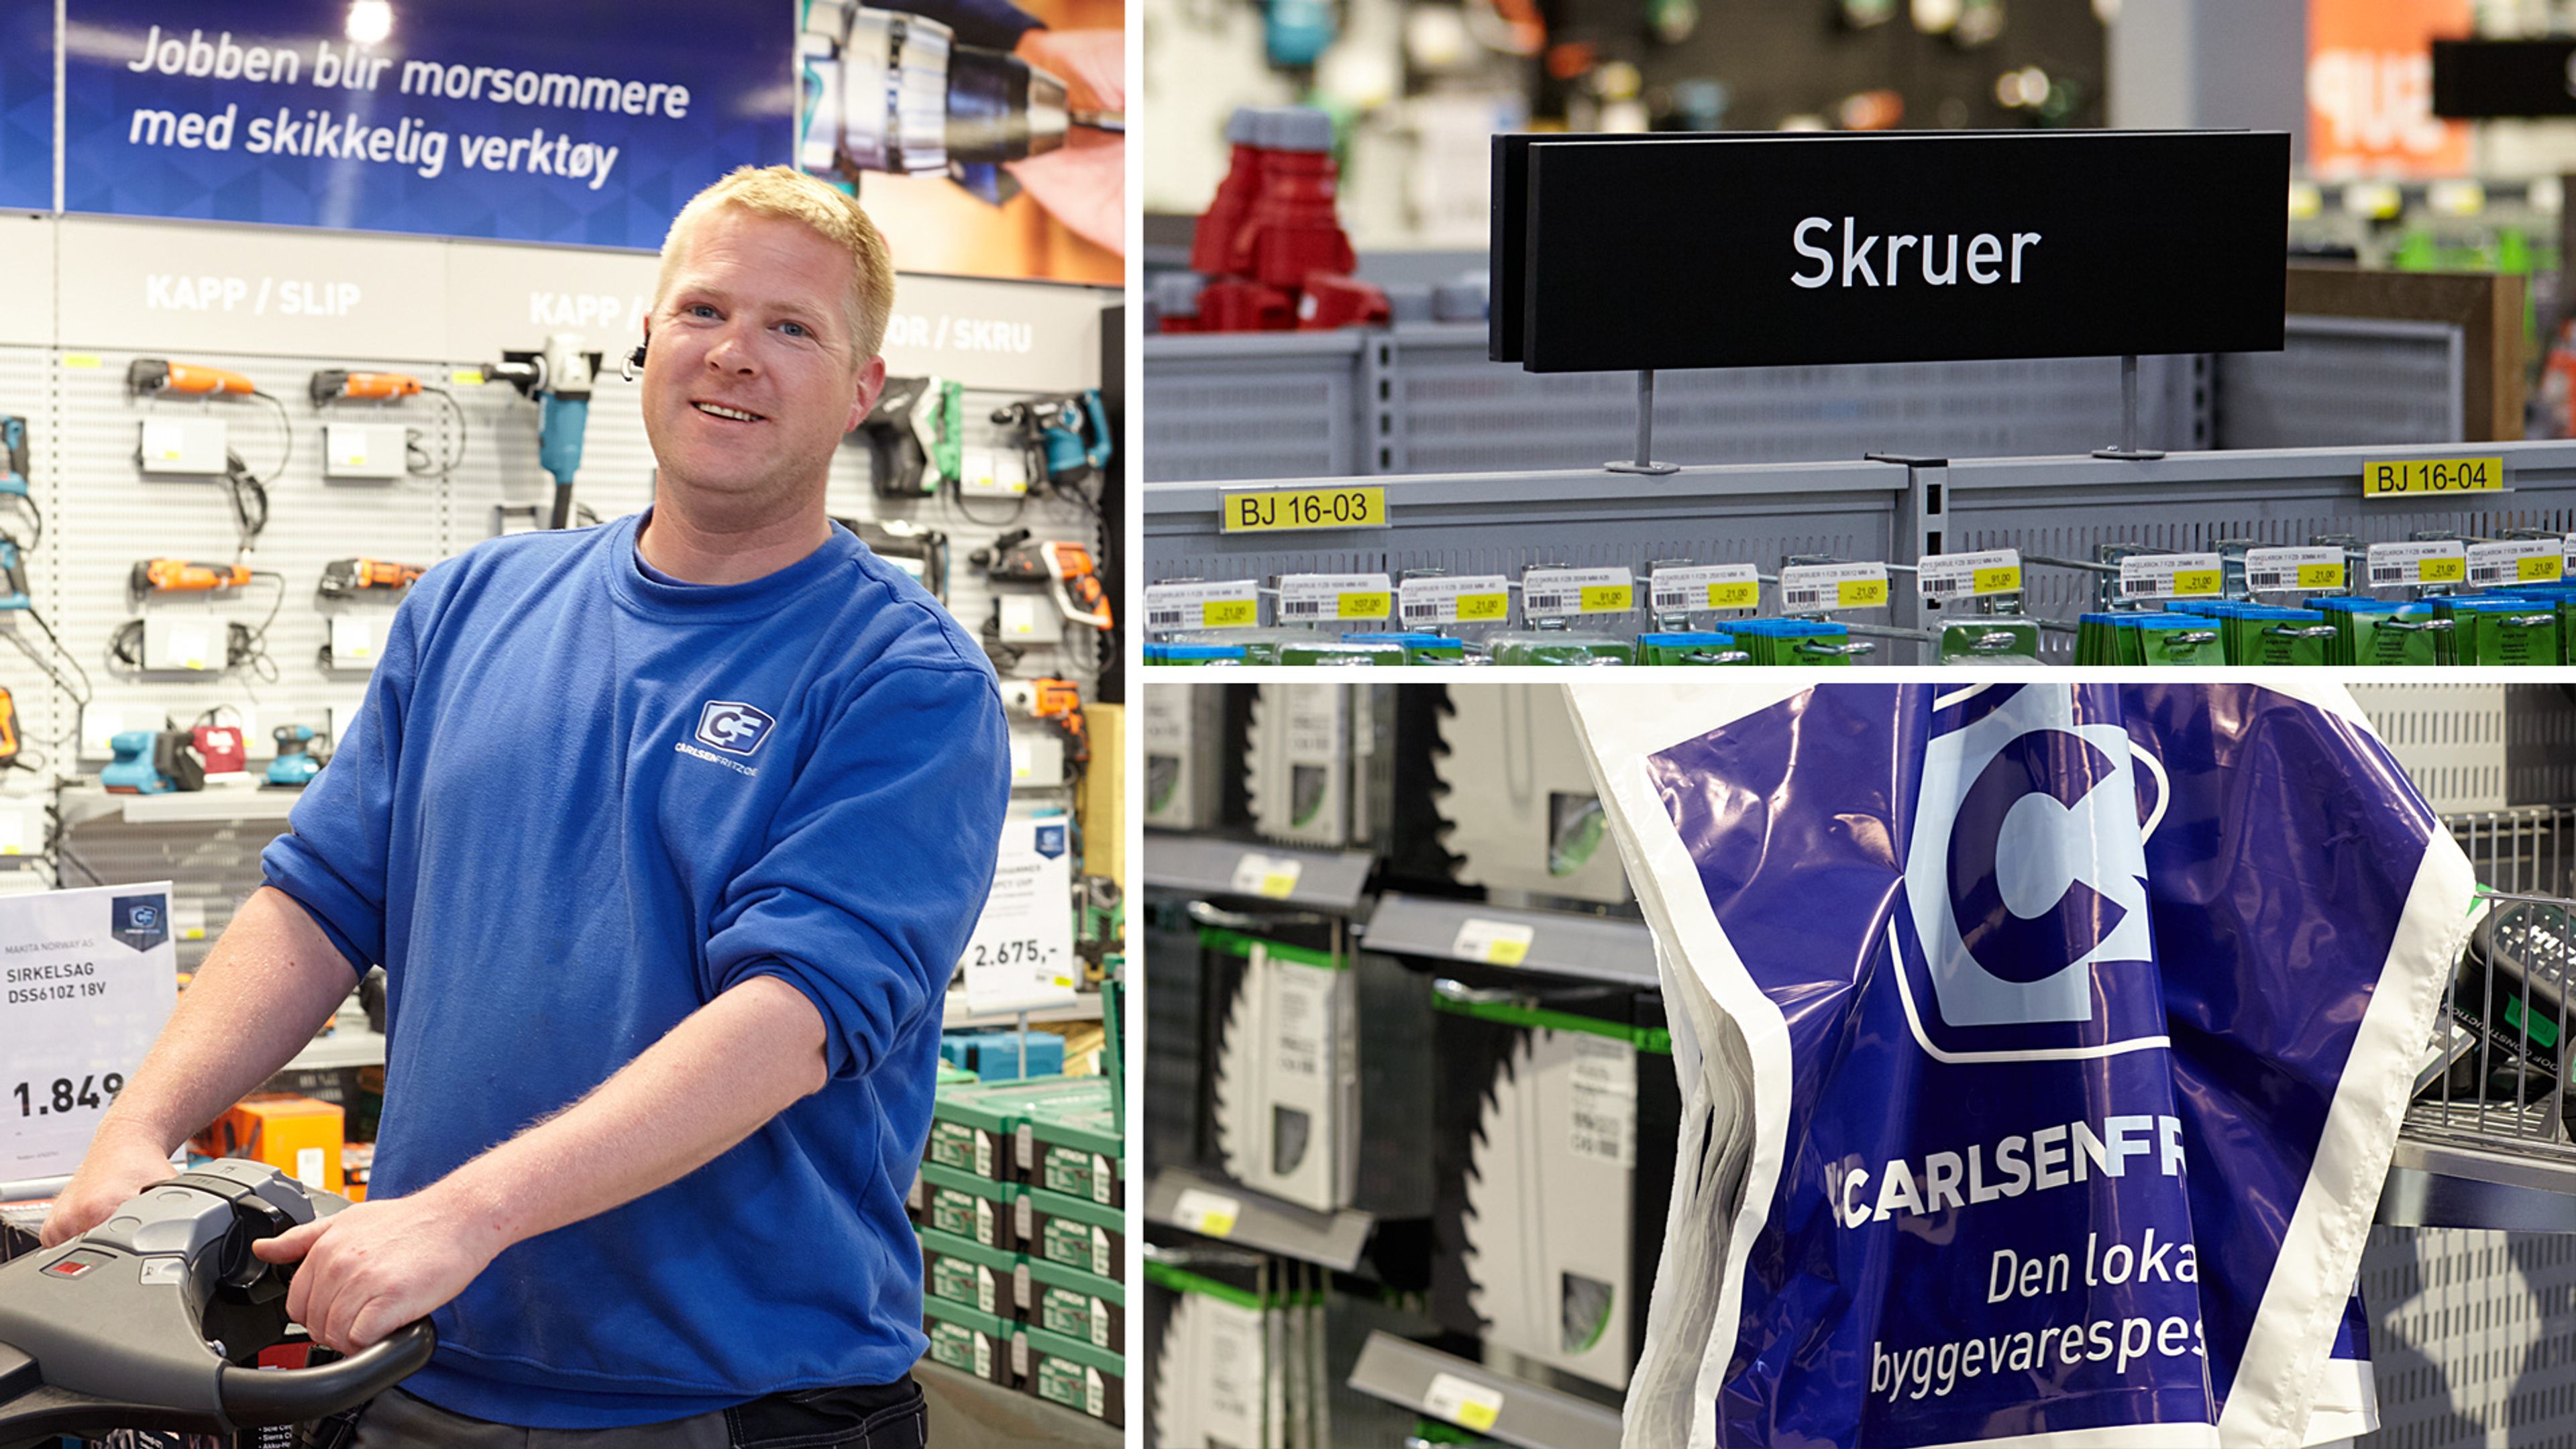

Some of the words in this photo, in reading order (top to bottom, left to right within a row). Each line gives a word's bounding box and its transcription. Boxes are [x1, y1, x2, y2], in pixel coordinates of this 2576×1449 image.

[128, 25, 299, 85] Jobben
[313, 40, 393, 91] blir
[400, 60, 690, 119] morsommere
[129, 103, 237, 150] med
[246, 107, 448, 178] skikkelig
[460, 128, 619, 190] verktøy
[1790, 216, 2041, 288] Skruer
[146, 274, 247, 311] KAPP
[279, 280, 362, 316] SLIP
[531, 292, 621, 327] KAPP
[954, 318, 1032, 354] SKRU
[2378, 465, 2408, 492] BJ
[2419, 462, 2487, 490] 16-04
[1241, 498, 1275, 526] BJ
[1289, 493, 1367, 523] 16-03
[5, 944, 39, 954] MAKITA
[42, 940, 79, 951] NORWAY
[82, 939, 94, 947] AS
[975, 940, 1057, 966] 2.675,-
[7, 962, 94, 983] SIRKELSAG
[9, 985, 74, 1004] DSS610Z
[80, 981, 106, 997] 18V
[13, 1073, 124, 1118] 1.849
[1987, 1249, 2070, 1304] Den
[2086, 1228, 2198, 1287] loka
